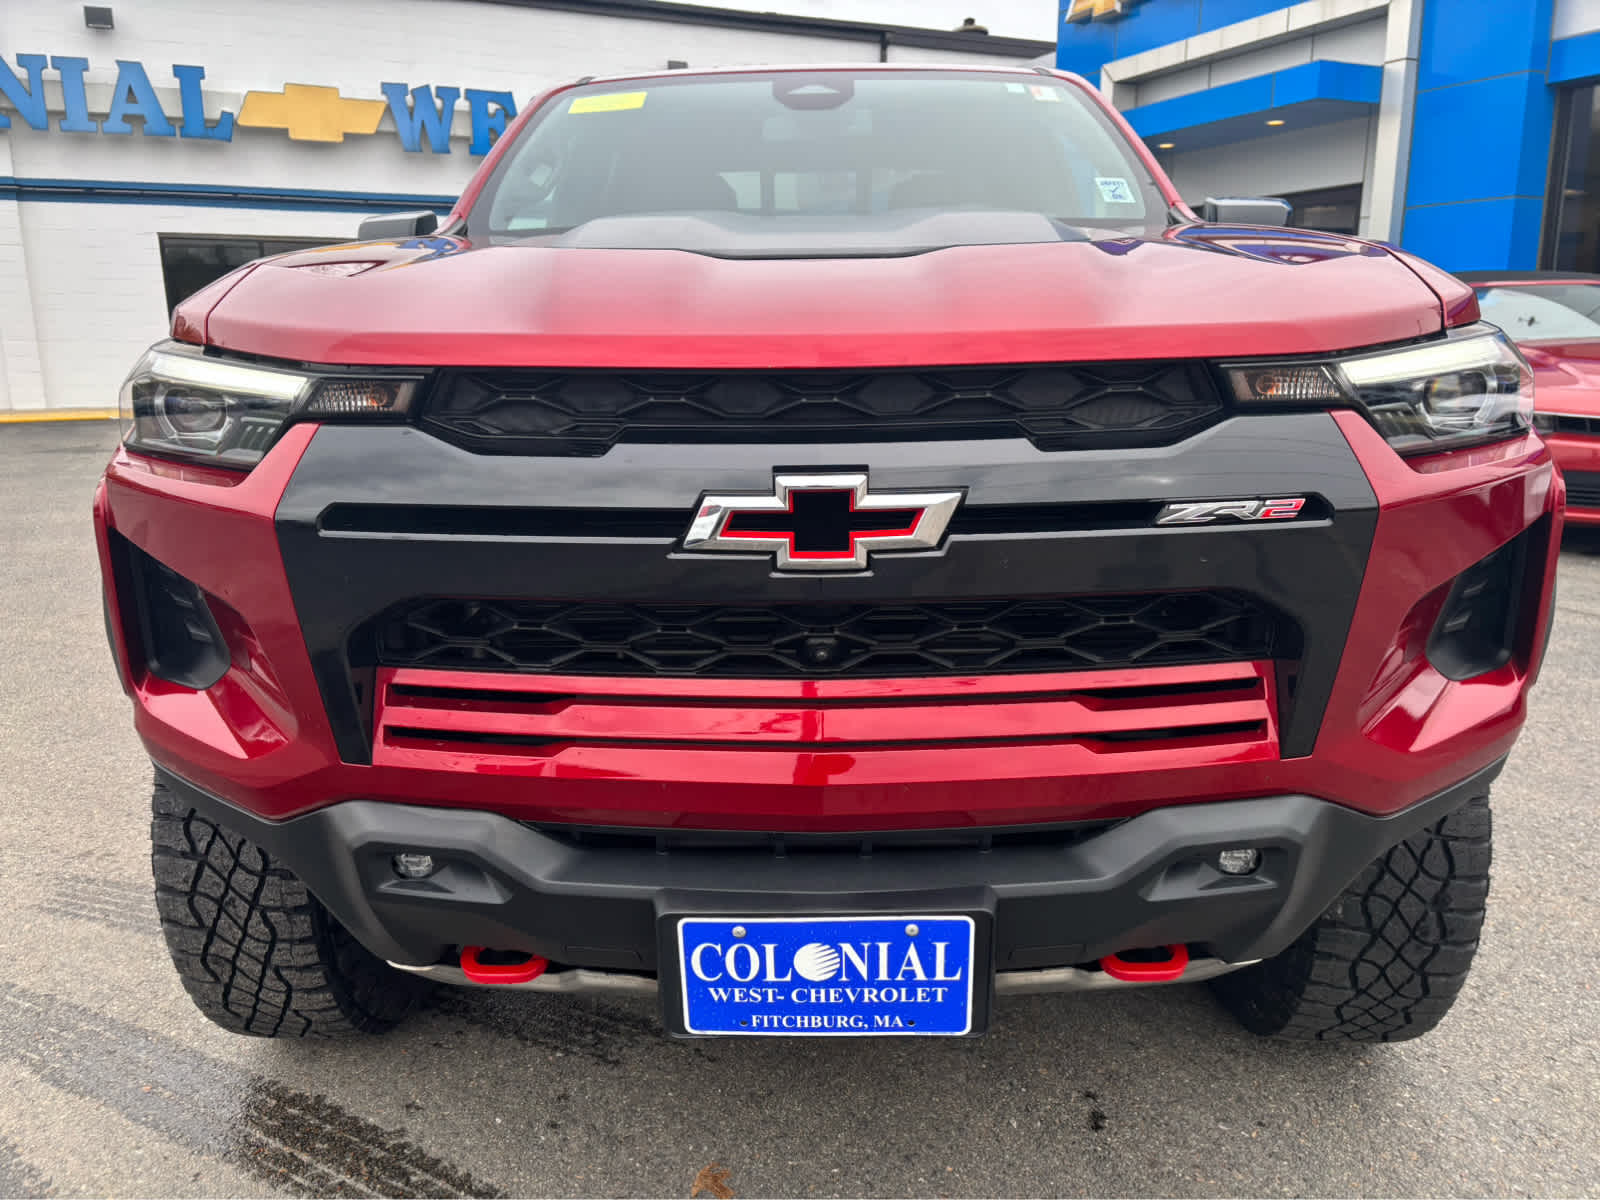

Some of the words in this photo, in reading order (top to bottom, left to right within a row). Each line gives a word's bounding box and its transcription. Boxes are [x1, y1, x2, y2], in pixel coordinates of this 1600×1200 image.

[1156, 498, 1306, 525] ZR2
[691, 942, 962, 982] COLONIAL
[708, 988, 785, 1003] WEST-
[791, 987, 948, 1003] CHEVROLET
[751, 1015, 868, 1029] FITCHBURG,
[874, 1015, 904, 1028] MA
